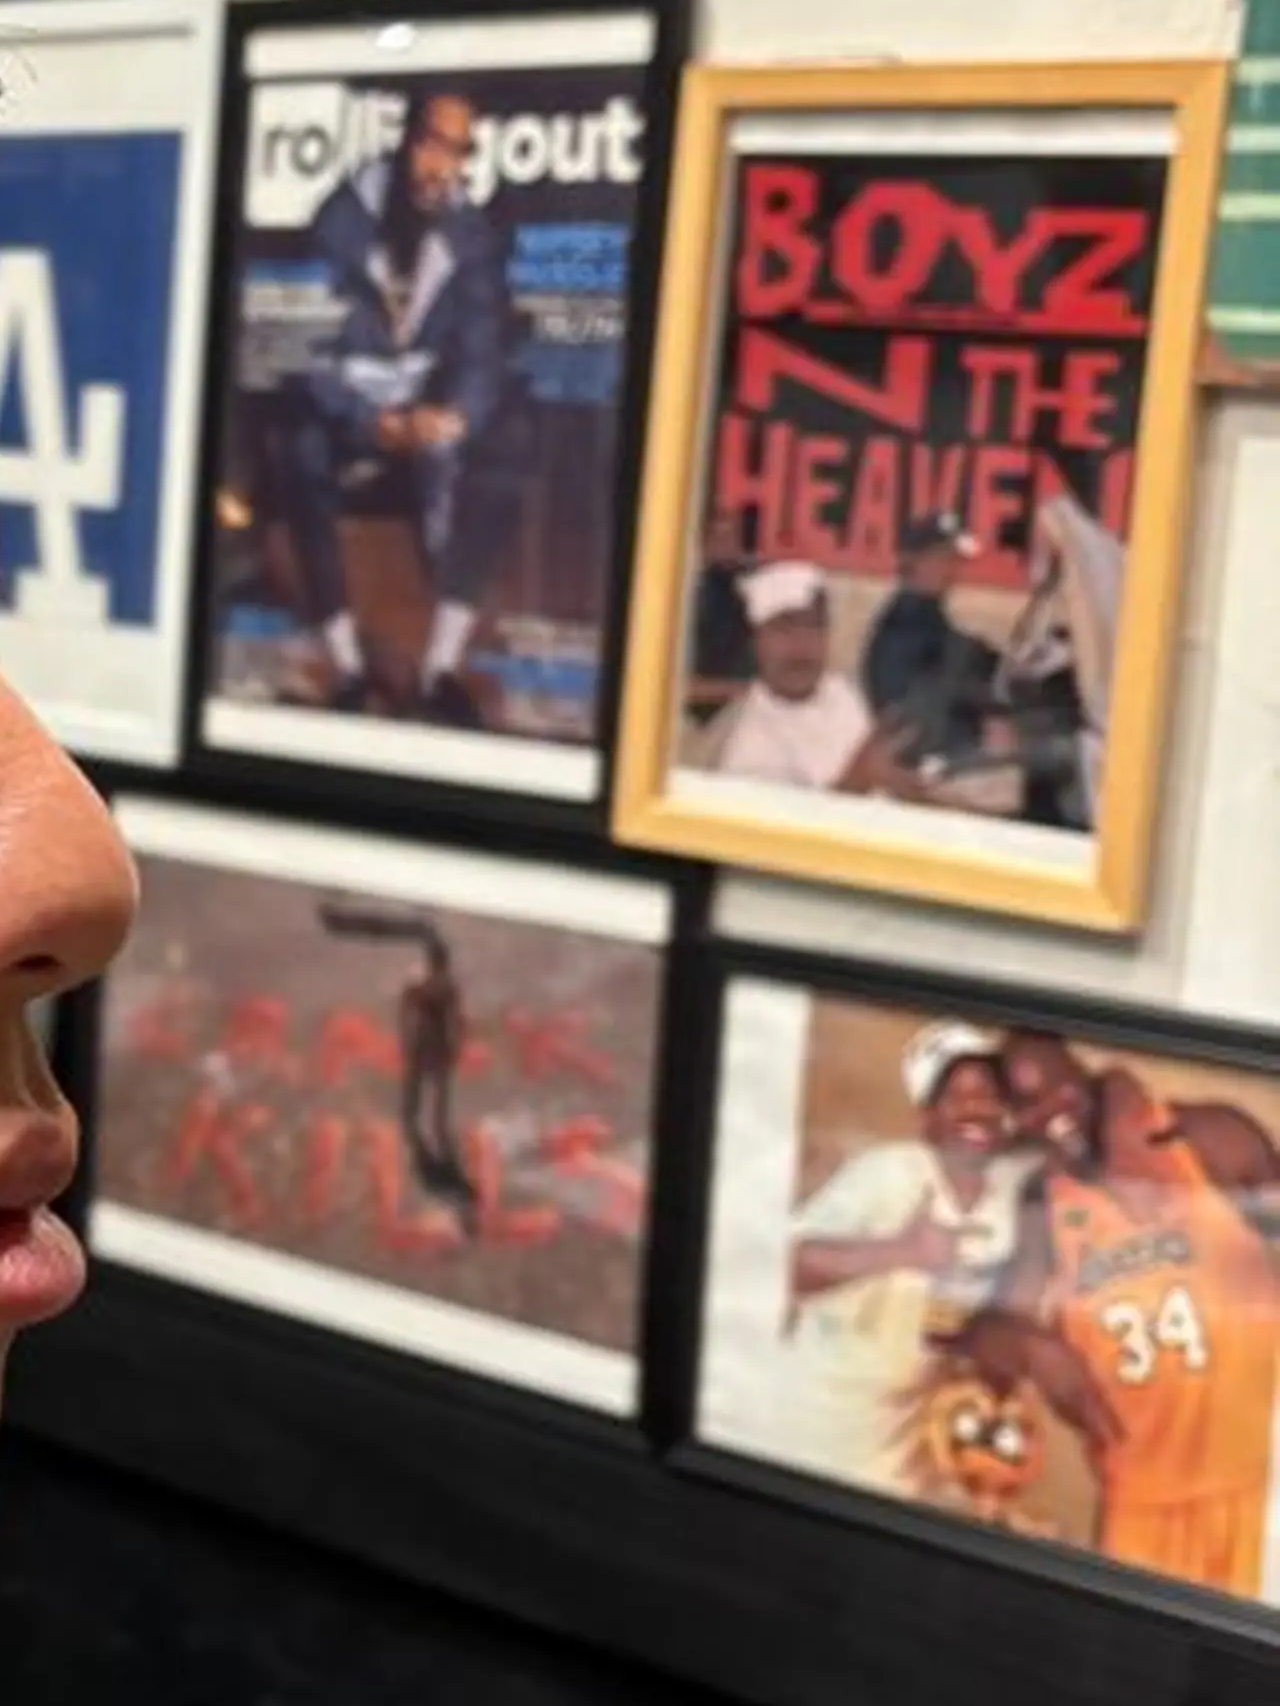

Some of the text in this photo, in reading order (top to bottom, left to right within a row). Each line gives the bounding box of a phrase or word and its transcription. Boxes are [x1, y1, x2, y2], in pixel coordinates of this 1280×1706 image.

[737, 163, 1152, 336] BOYZ
[739, 328, 931, 431] N
[960, 347, 1123, 451] THE
[1097, 1283, 1208, 1384] 34
